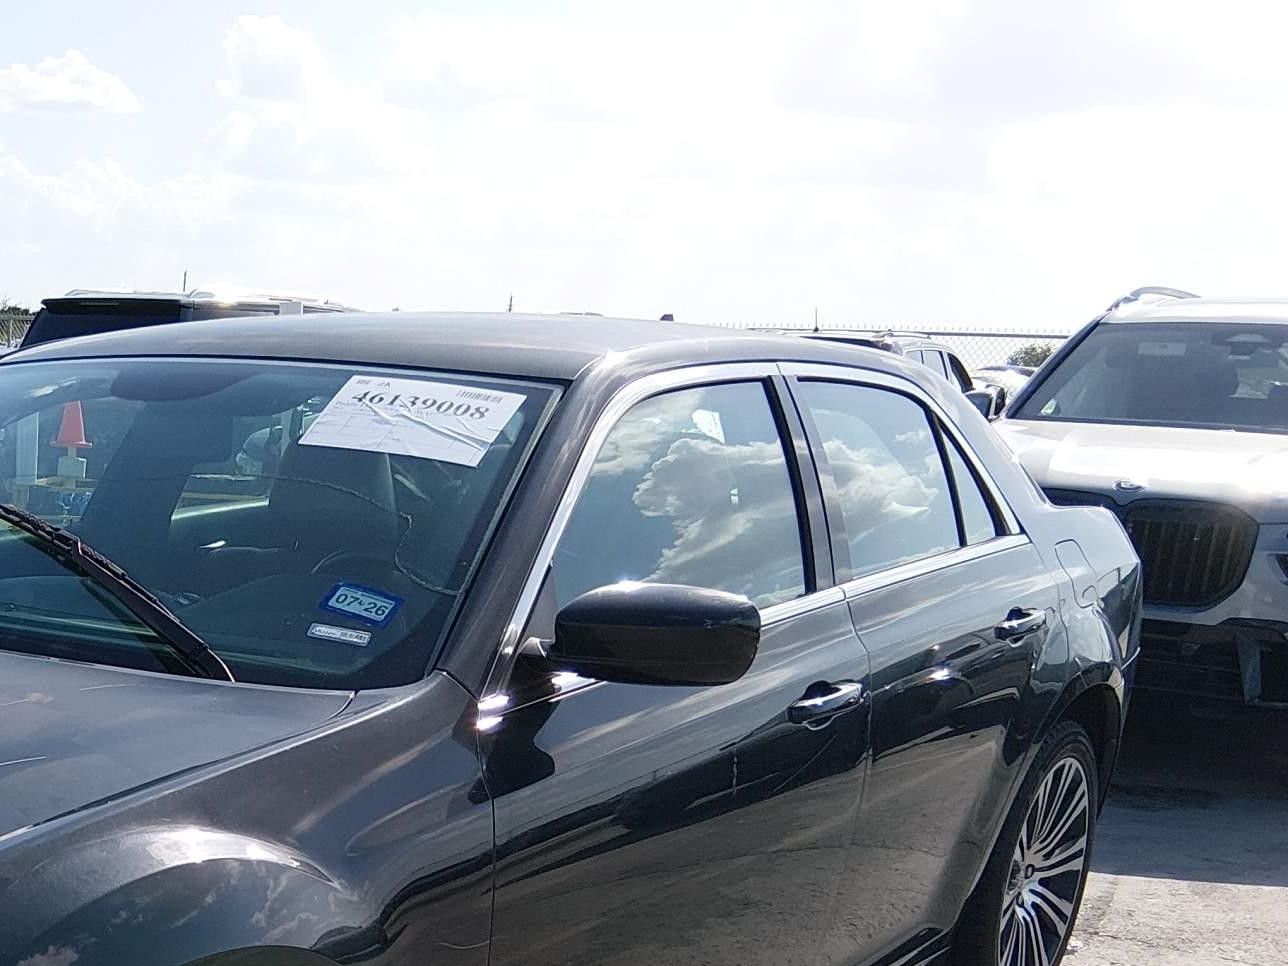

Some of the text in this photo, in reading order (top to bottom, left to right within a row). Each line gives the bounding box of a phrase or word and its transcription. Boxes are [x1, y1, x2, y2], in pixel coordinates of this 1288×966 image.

[351, 390, 491, 421] 46139008
[335, 593, 361, 607] 07
[363, 601, 389, 617] 26
